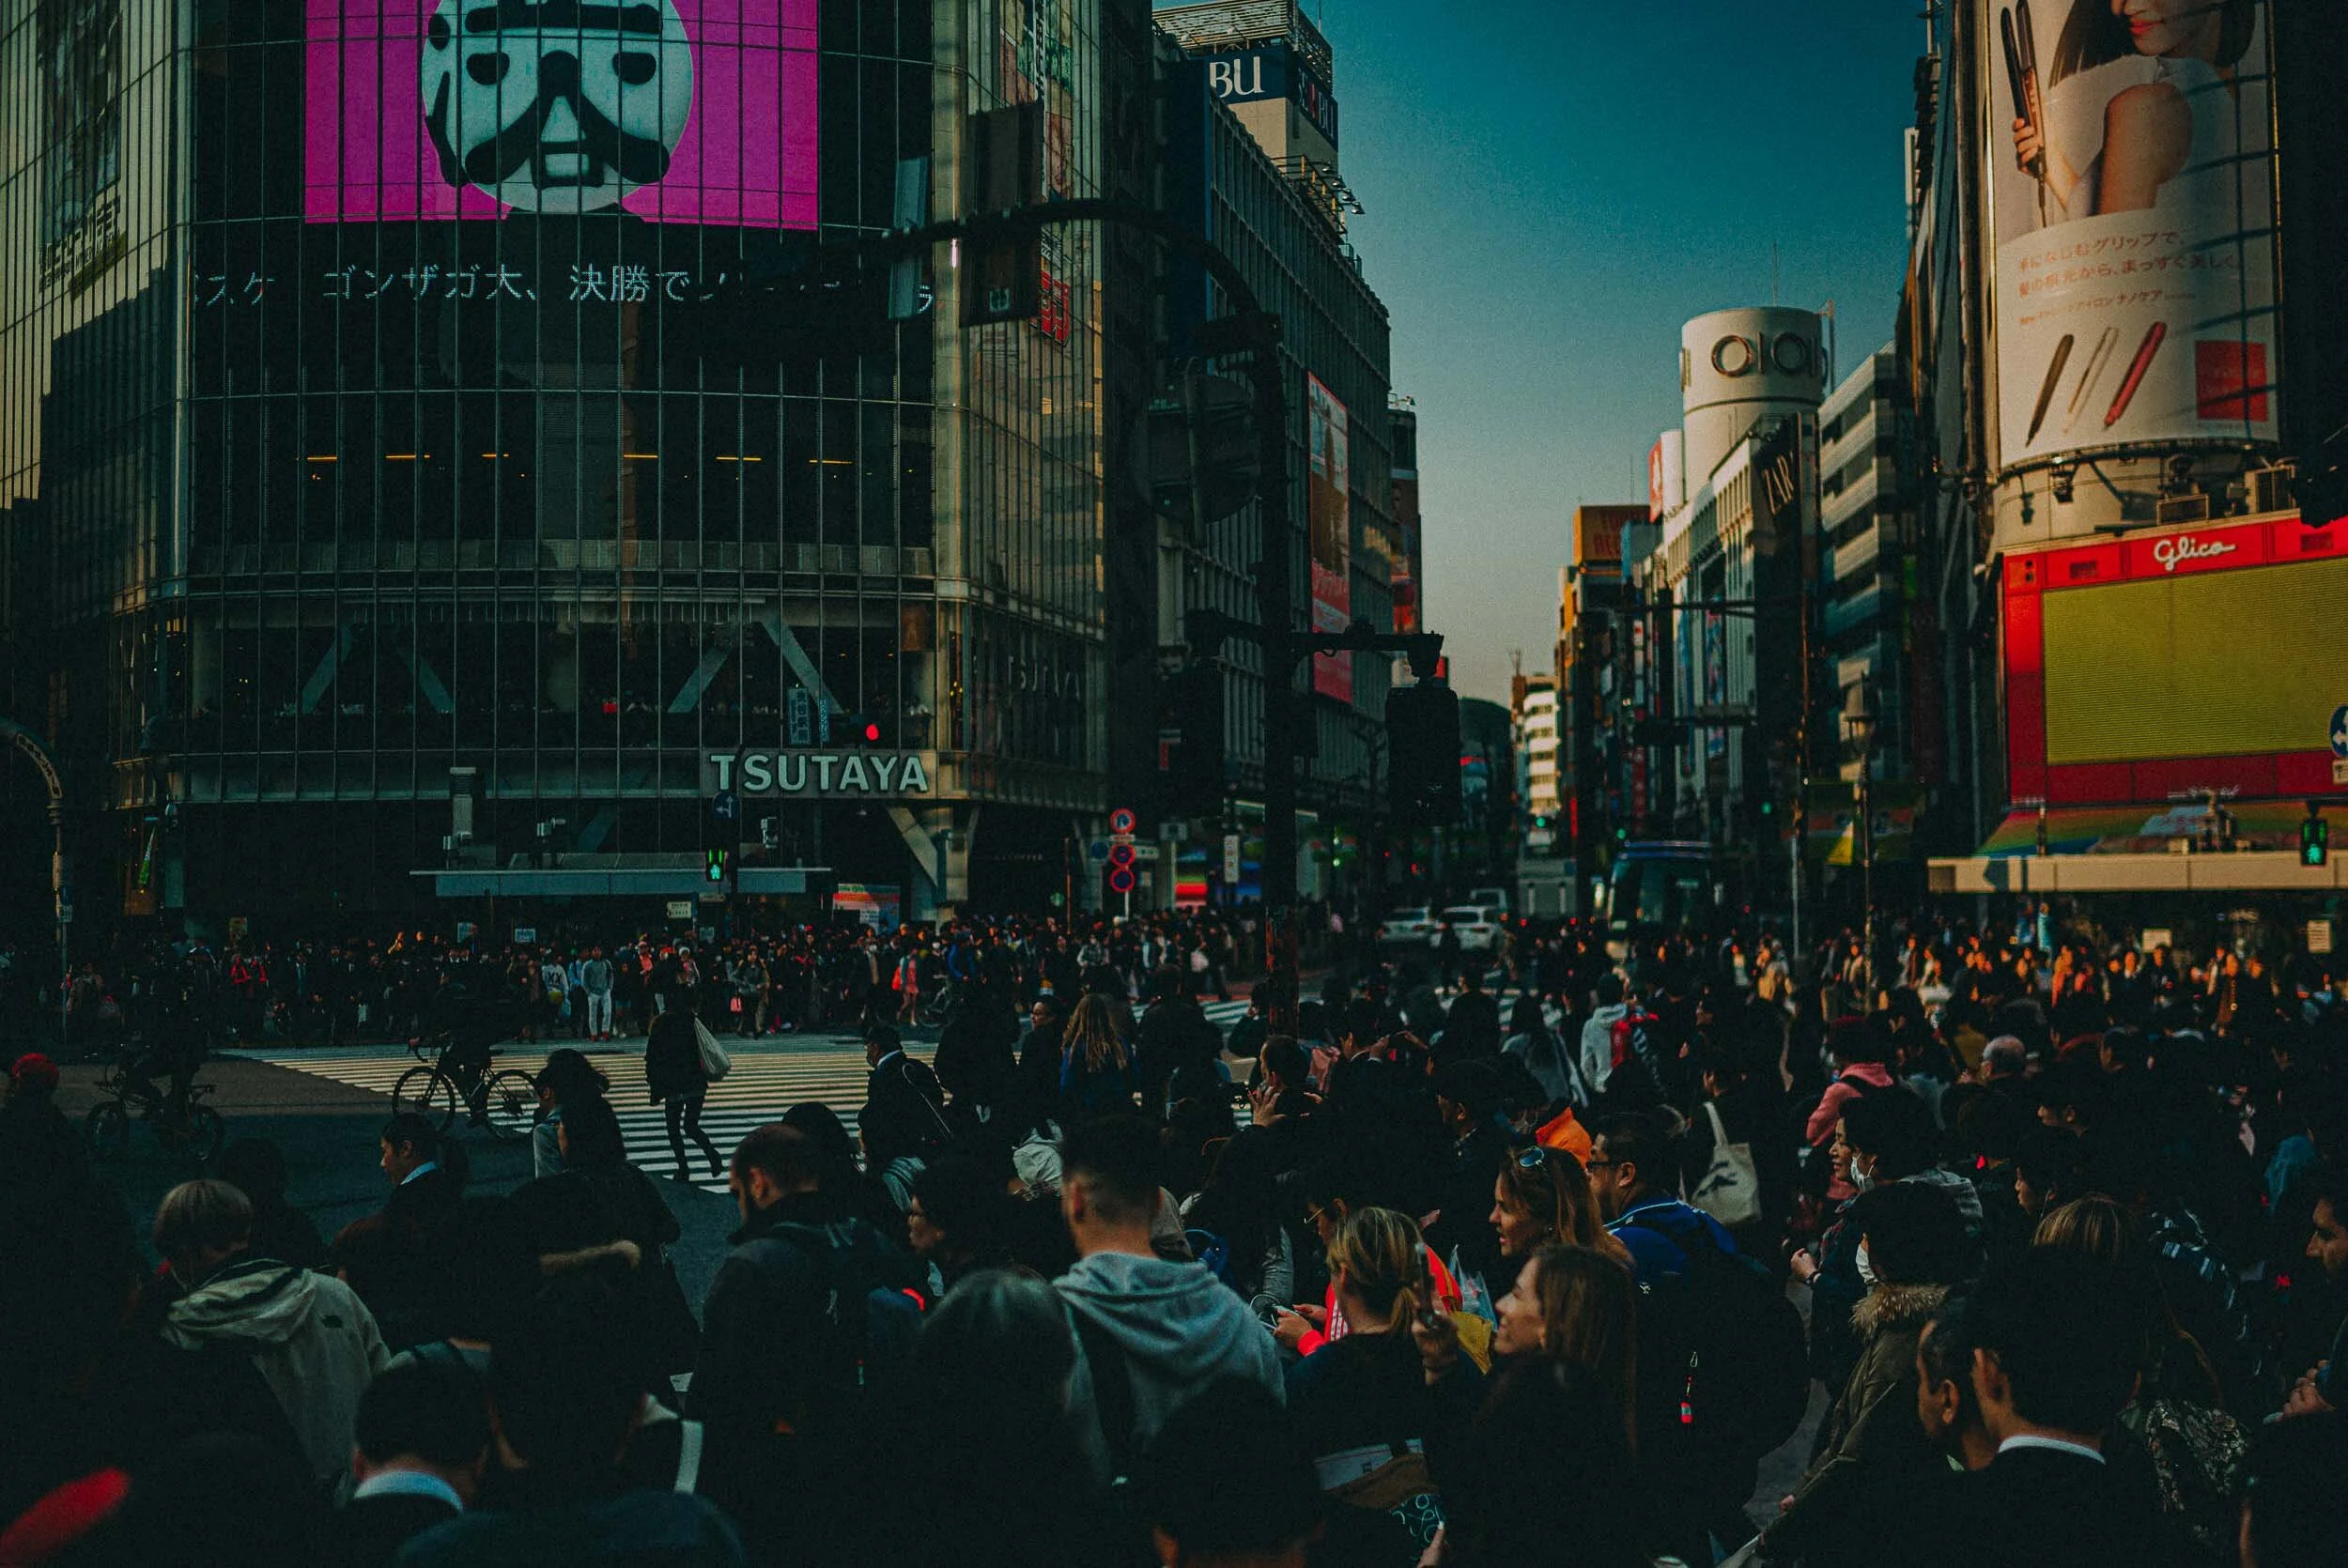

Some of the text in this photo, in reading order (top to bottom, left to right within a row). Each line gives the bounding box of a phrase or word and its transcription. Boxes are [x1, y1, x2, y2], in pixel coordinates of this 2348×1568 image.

[1762, 450, 1795, 516] ZAR
[2154, 535, 2236, 572] Glico
[710, 754, 929, 792] TSUTAYA
